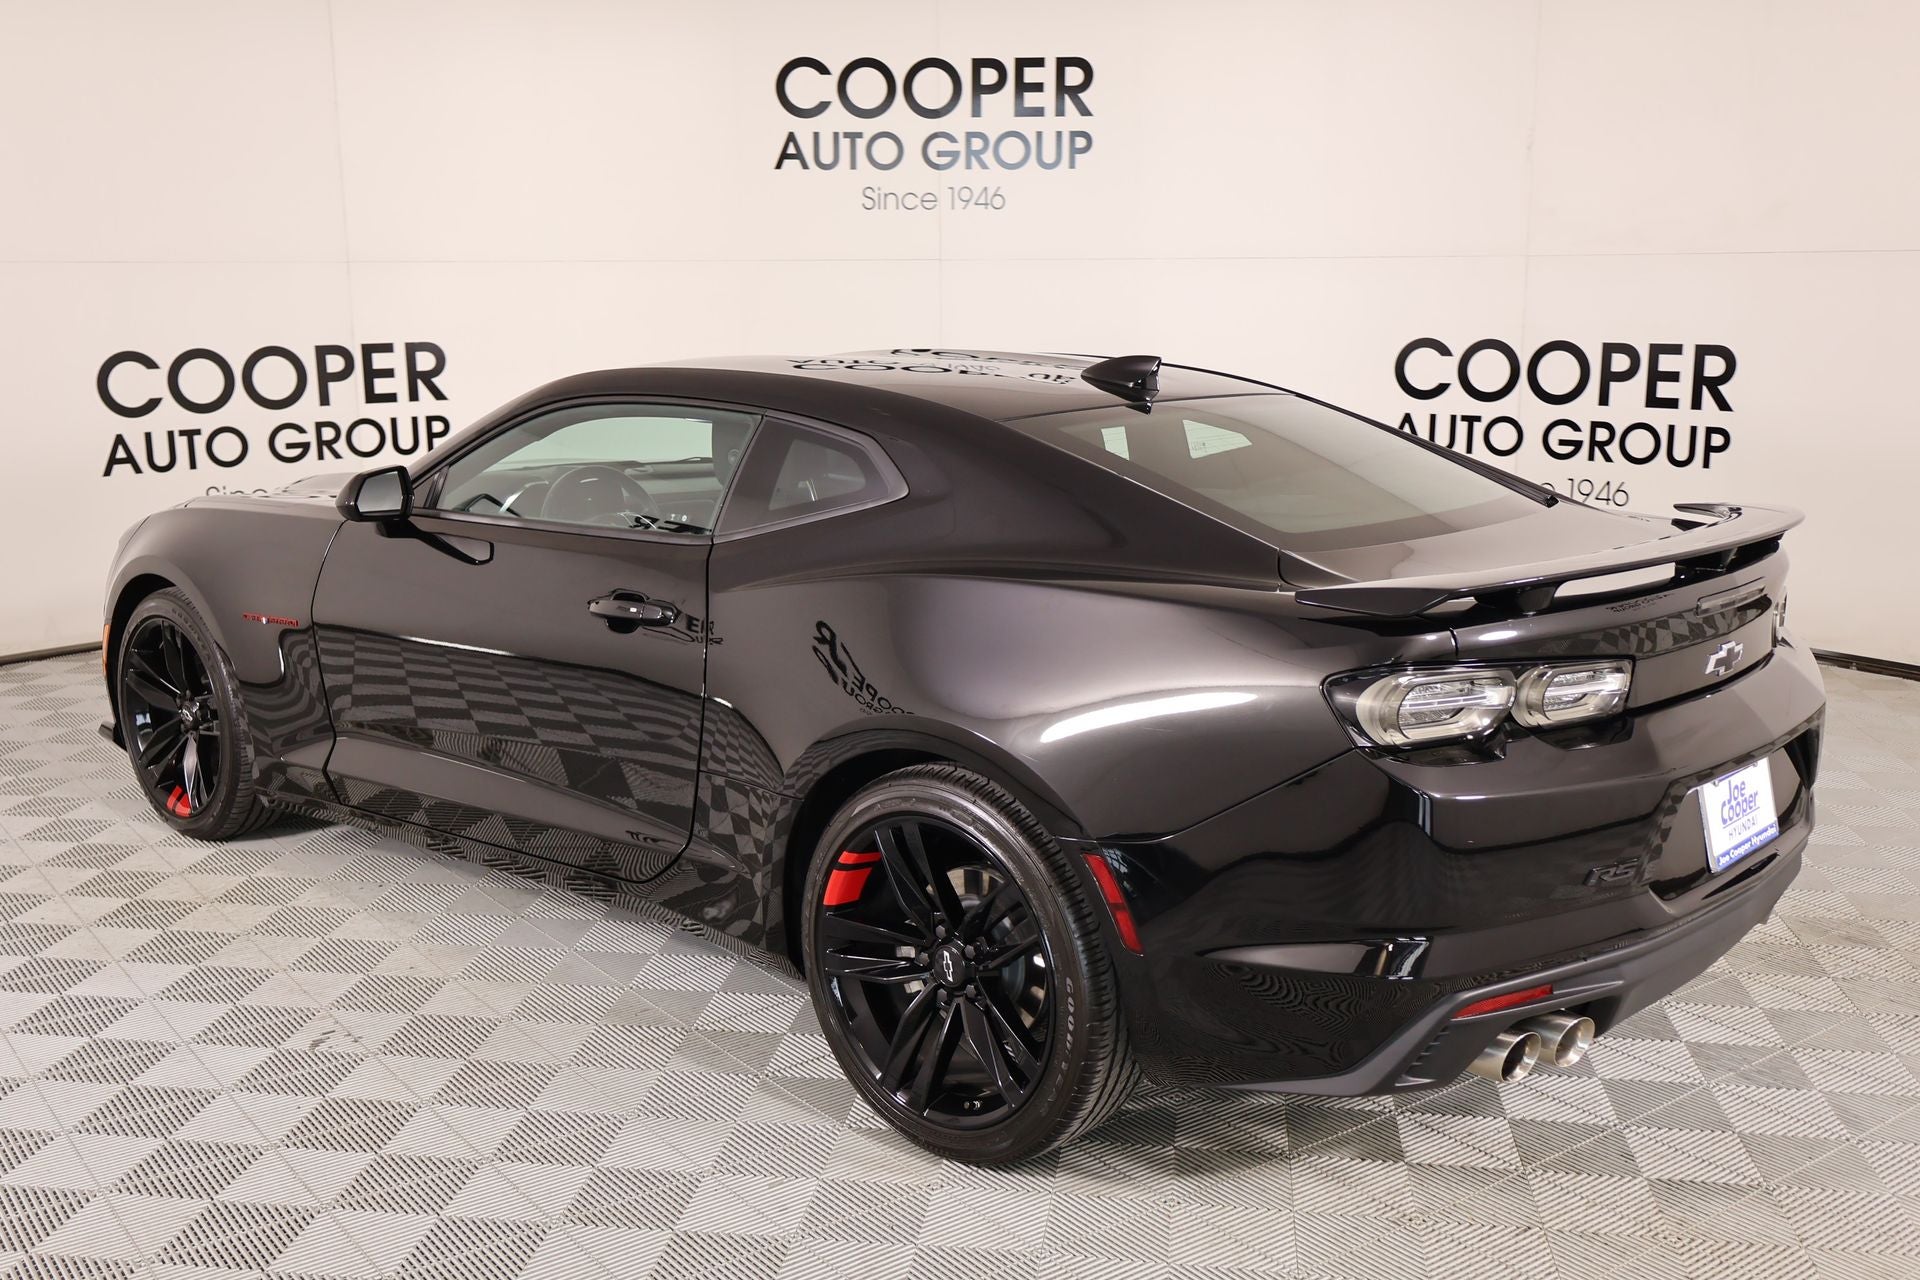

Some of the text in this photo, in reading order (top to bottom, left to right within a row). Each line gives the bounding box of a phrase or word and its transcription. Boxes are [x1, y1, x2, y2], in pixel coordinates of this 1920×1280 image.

[775, 56, 1094, 119] COOPER
[774, 130, 1093, 171] AUTO GROUP
[861, 186, 1006, 210] Since 1946
[97, 341, 450, 418] COOPER
[1395, 337, 1736, 412] COOPER
[102, 415, 451, 476] AUTO GROUP
[1542, 419, 1731, 469] GROUP
[1567, 478, 1629, 507] 1946
[1721, 790, 1758, 825] Cooper
[1727, 780, 1746, 805] Joe
[1719, 824, 1777, 866] Joe Cooper Hyundai
[1583, 858, 1640, 886] RS
